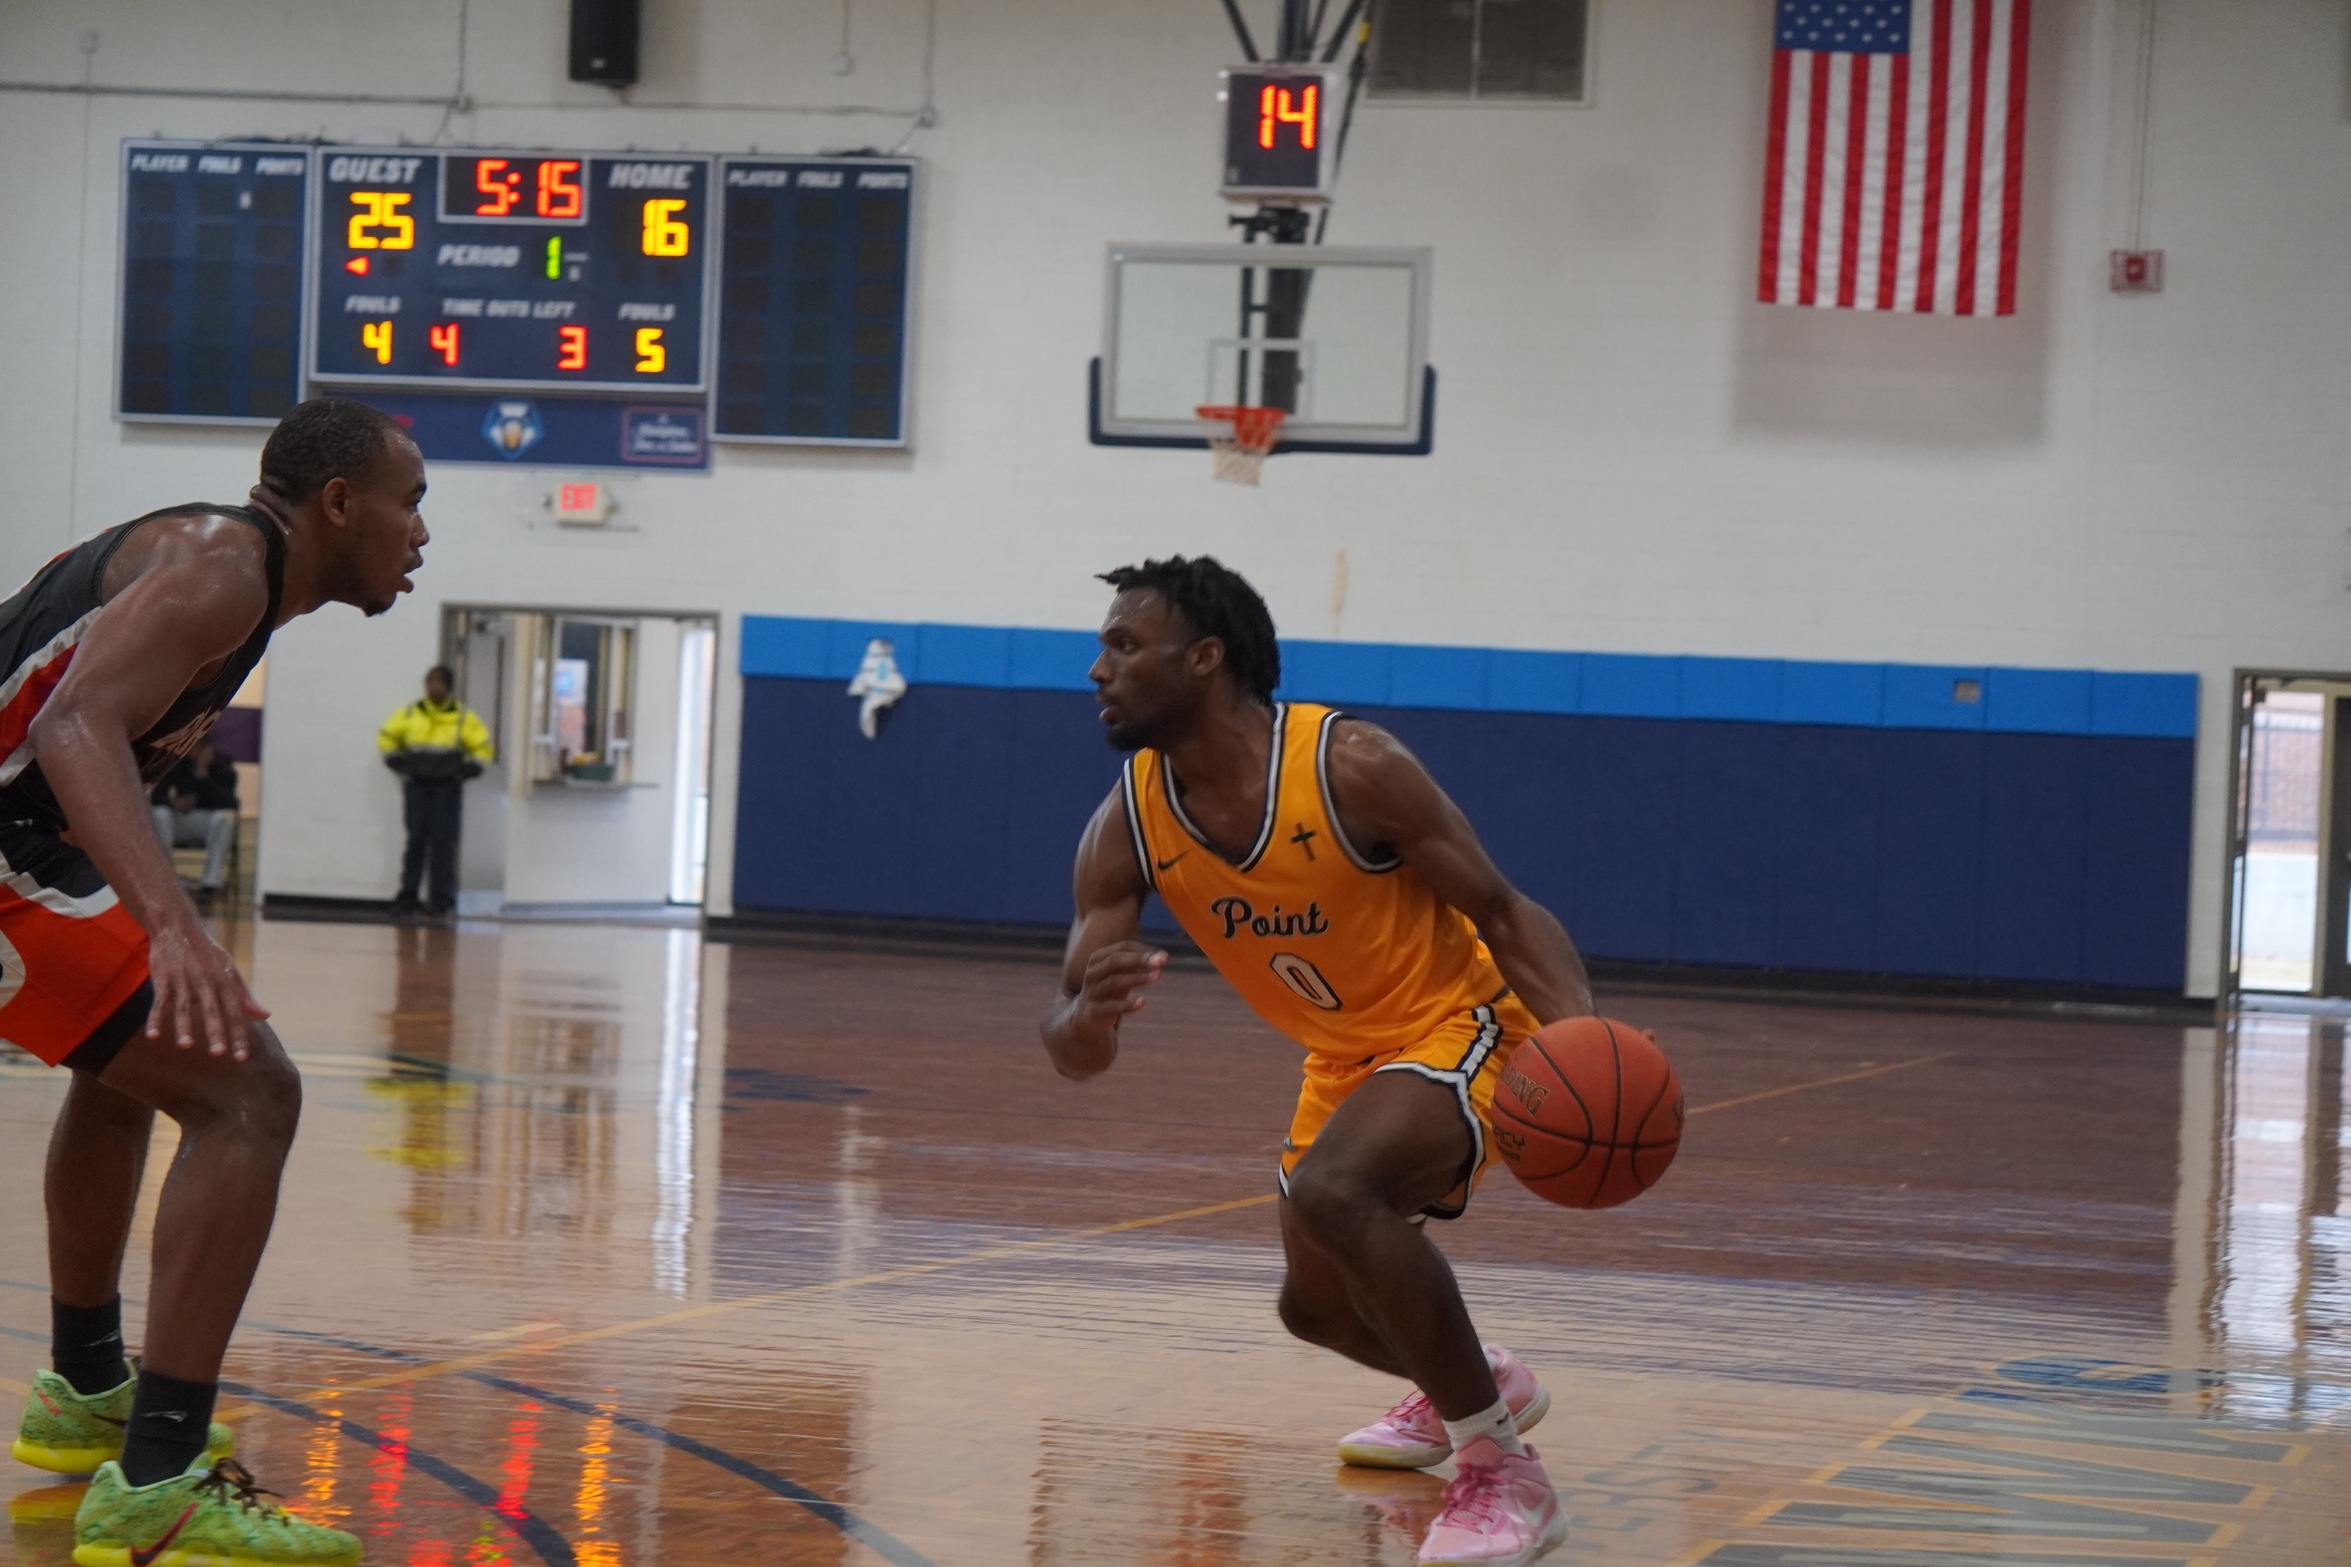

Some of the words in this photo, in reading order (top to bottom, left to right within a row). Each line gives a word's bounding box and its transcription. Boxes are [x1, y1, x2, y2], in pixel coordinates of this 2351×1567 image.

[1259, 84, 1318, 149] 14
[328, 156, 422, 184] GUEST
[475, 159, 582, 217] 5:15
[608, 164, 694, 189] HOME
[348, 192, 415, 250] 25
[642, 199, 689, 257] 16
[437, 244, 521, 268] PERIOD
[546, 236, 561, 280] 1
[532, 300, 576, 319] LEFT
[362, 320, 393, 365] 4
[429, 322, 460, 367] 4
[556, 325, 588, 371] 3
[634, 327, 666, 373] 5
[561, 483, 597, 511] EXIT
[1210, 895, 1330, 939] Point
[1269, 952, 1343, 1011] 0
